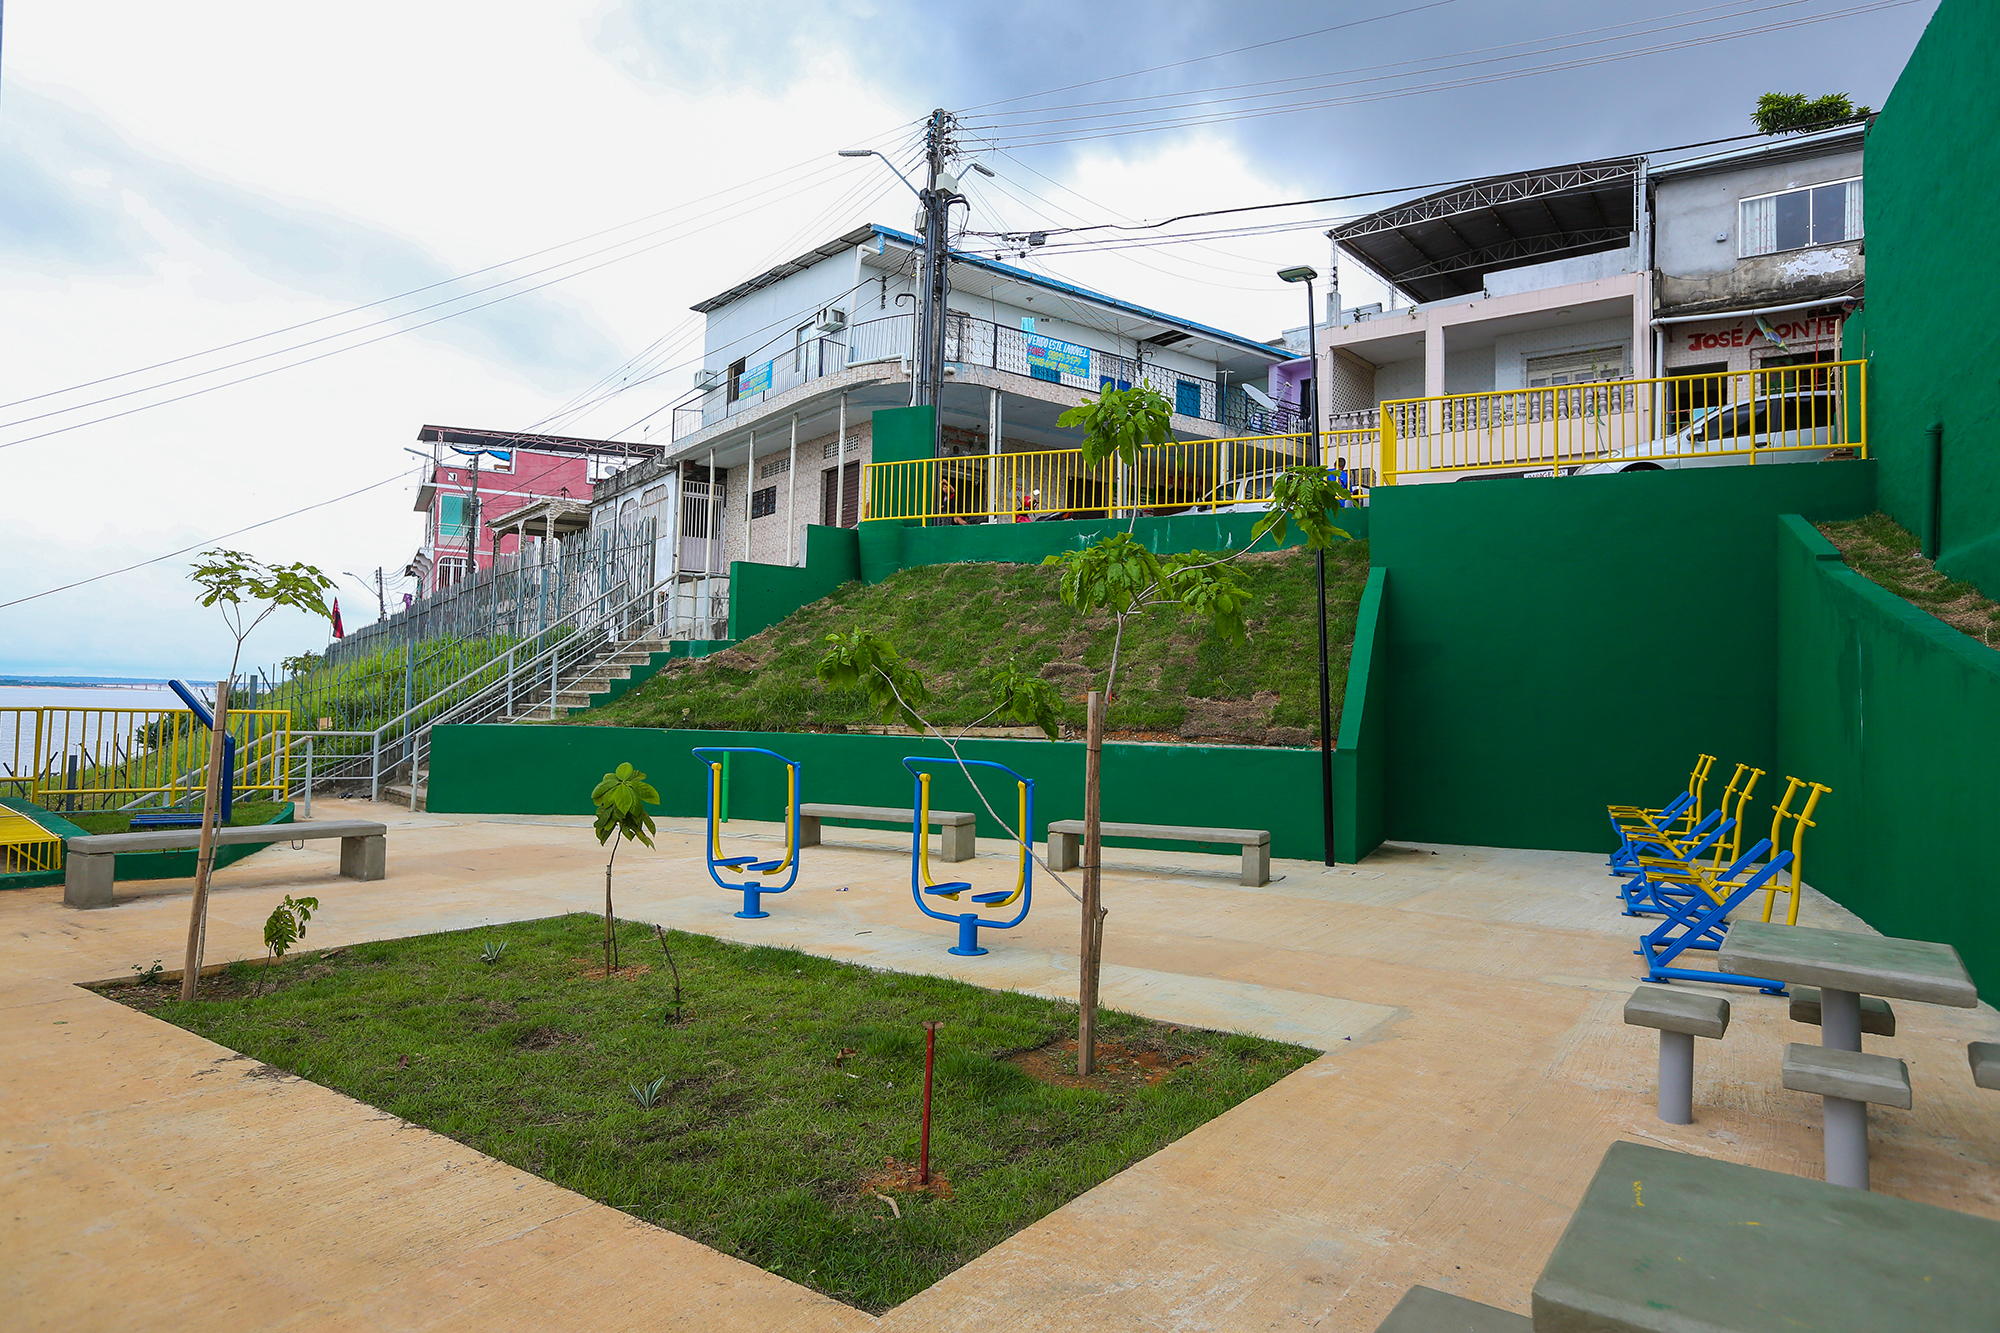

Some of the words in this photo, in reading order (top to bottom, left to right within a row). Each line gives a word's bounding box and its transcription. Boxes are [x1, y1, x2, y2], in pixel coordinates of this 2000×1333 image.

[1028, 334, 1048, 349] VENDO
[1048, 340, 1063, 351] ESTE
[1688, 321, 1743, 351] JOSÉ
